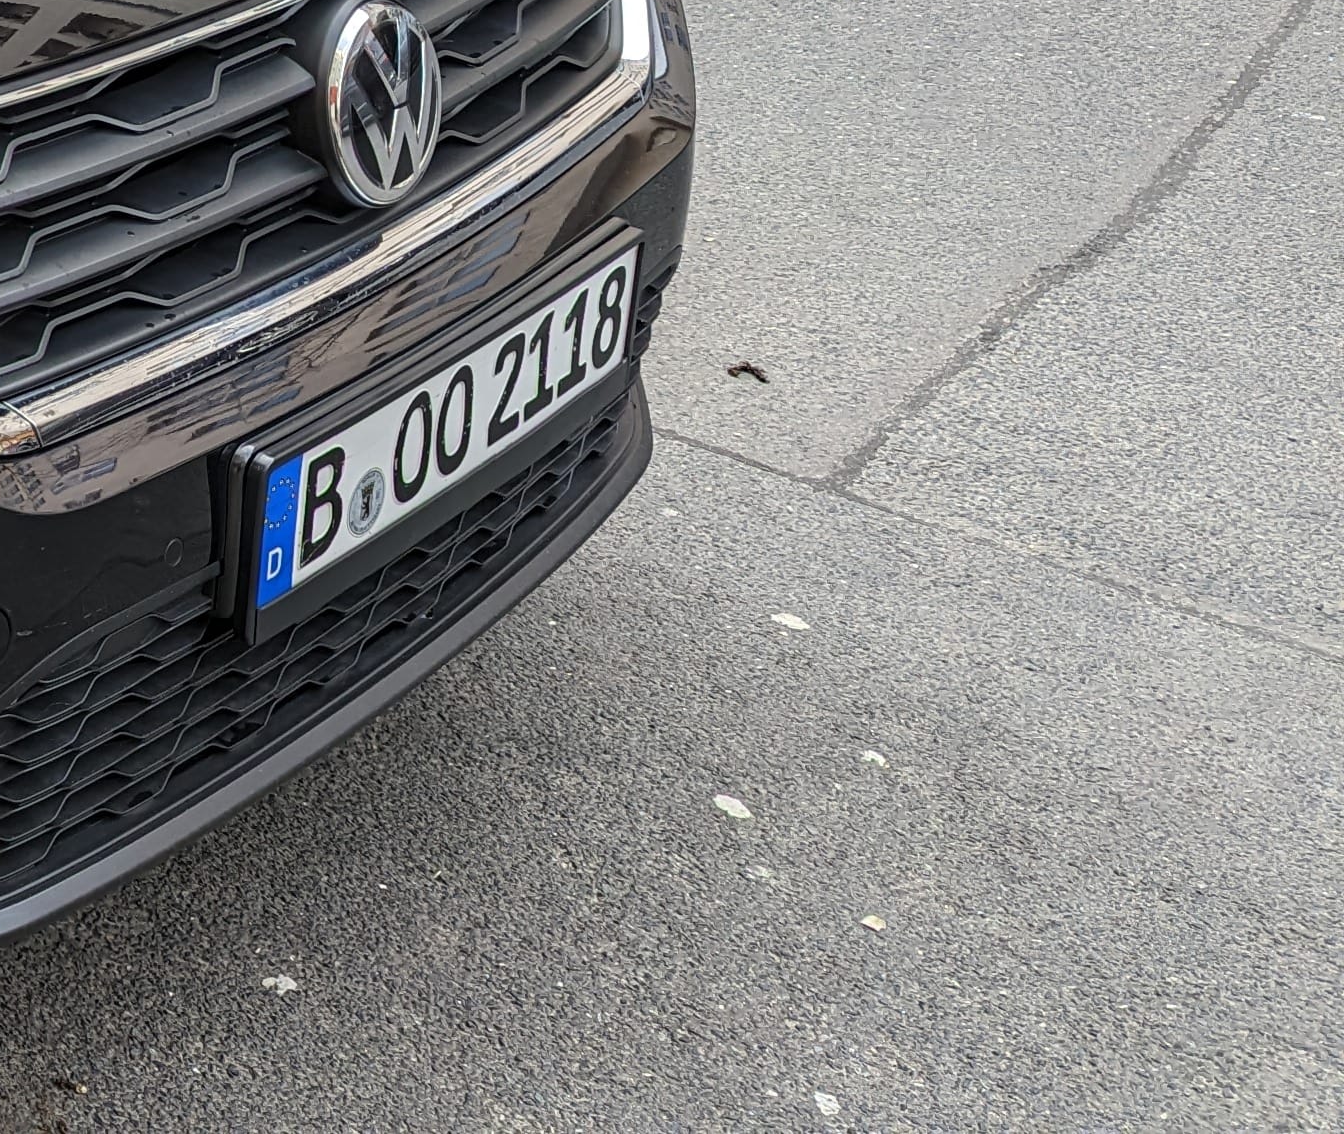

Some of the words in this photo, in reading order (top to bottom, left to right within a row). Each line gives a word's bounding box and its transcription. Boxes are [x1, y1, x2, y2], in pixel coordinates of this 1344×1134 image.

[298, 445, 346, 571] B
[393, 364, 475, 504] OO
[487, 265, 628, 447] 2118
[266, 546, 283, 581] D
